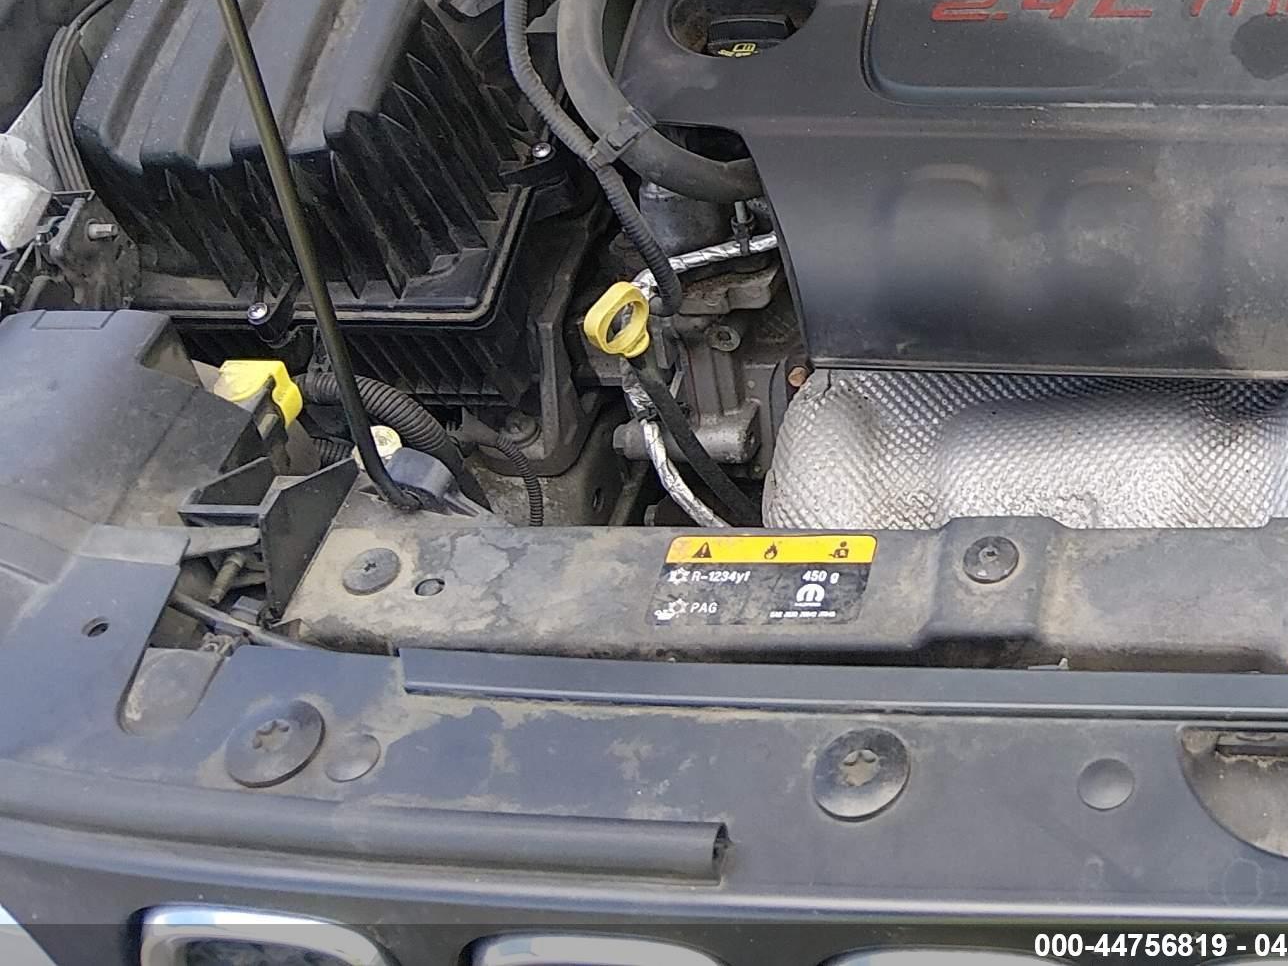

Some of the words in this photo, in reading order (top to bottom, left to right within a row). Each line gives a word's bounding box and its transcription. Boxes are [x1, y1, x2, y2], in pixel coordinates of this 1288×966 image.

[690, 570, 751, 584] R-1234yf
[802, 570, 827, 582] 450
[829, 572, 840, 584] g
[690, 602, 719, 614] PAG
